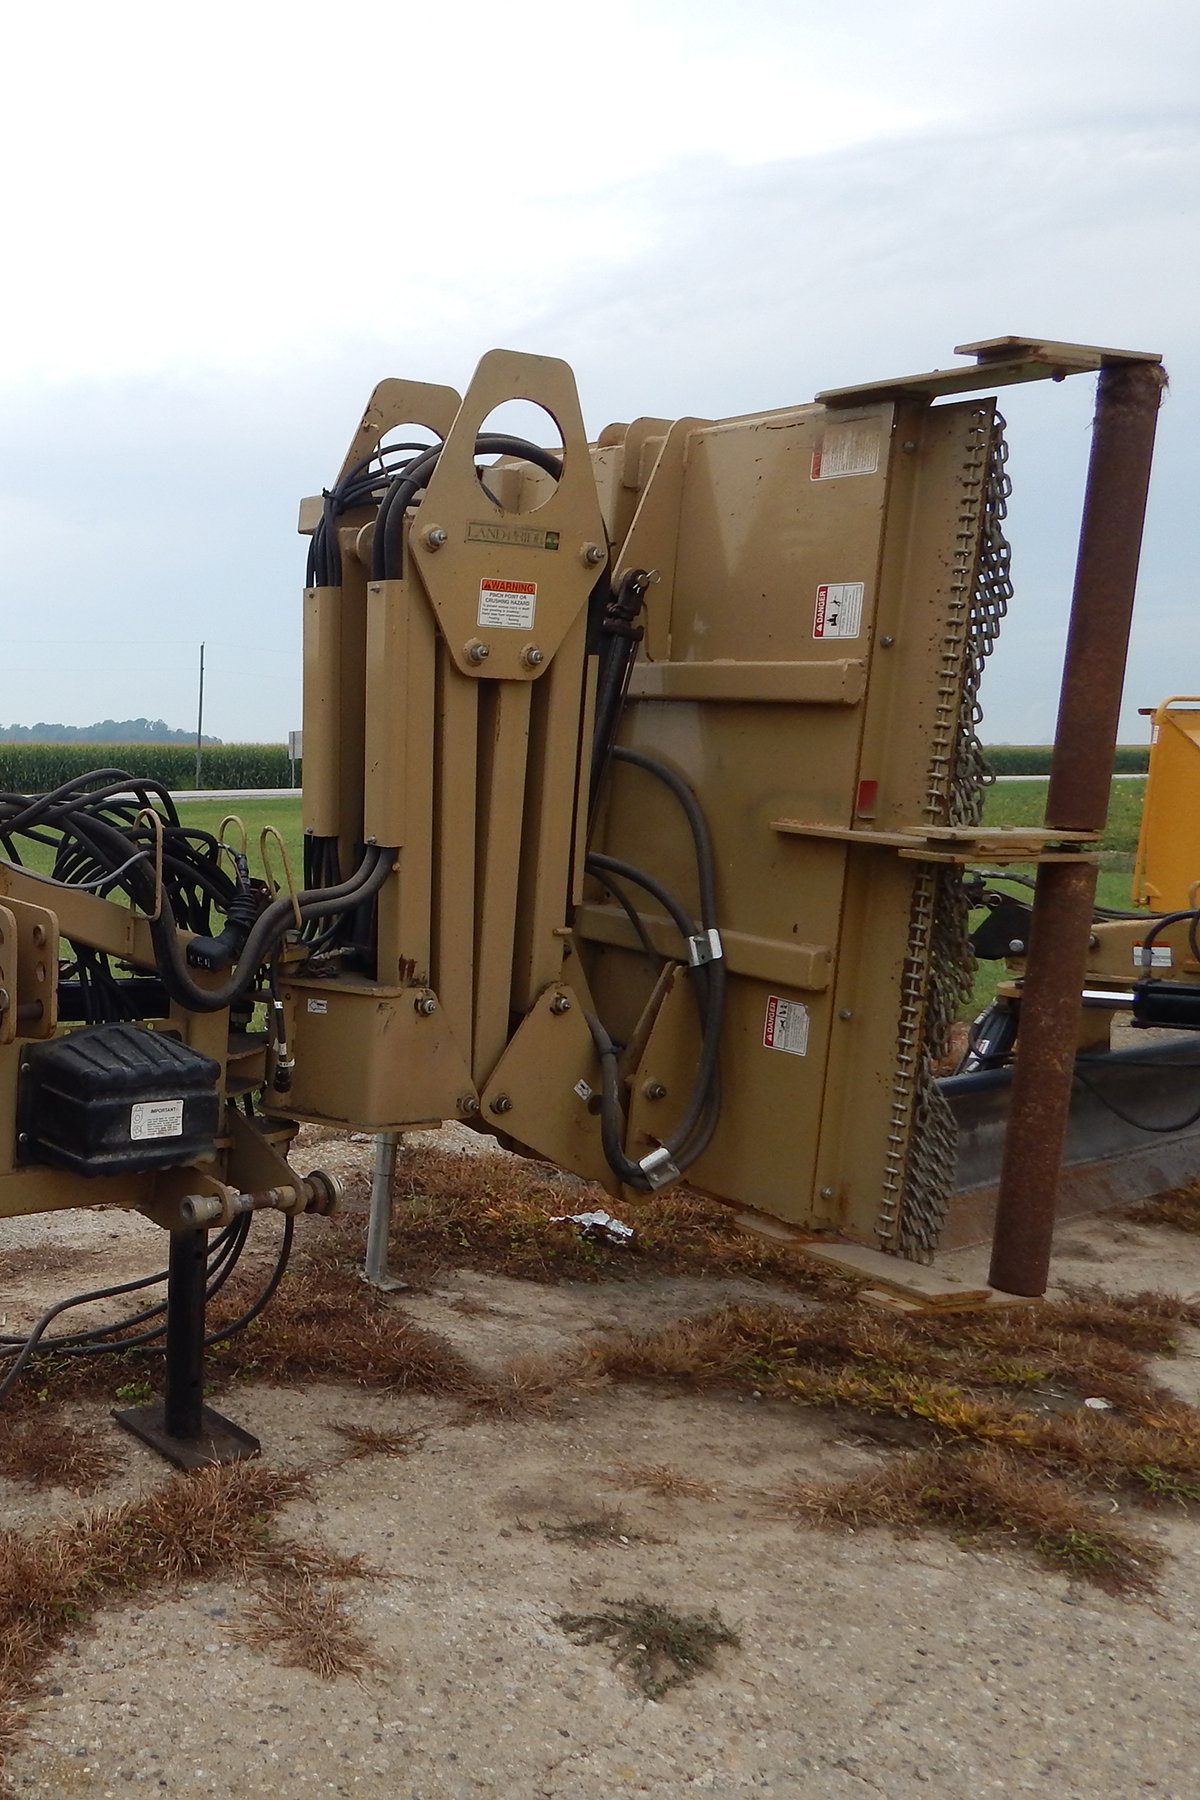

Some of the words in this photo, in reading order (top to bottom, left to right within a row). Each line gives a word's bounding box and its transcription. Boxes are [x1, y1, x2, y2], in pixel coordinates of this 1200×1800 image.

[491, 580, 534, 592] WARNING
[816, 590, 826, 624] DANGER
[766, 1002, 776, 1033] DANGER
